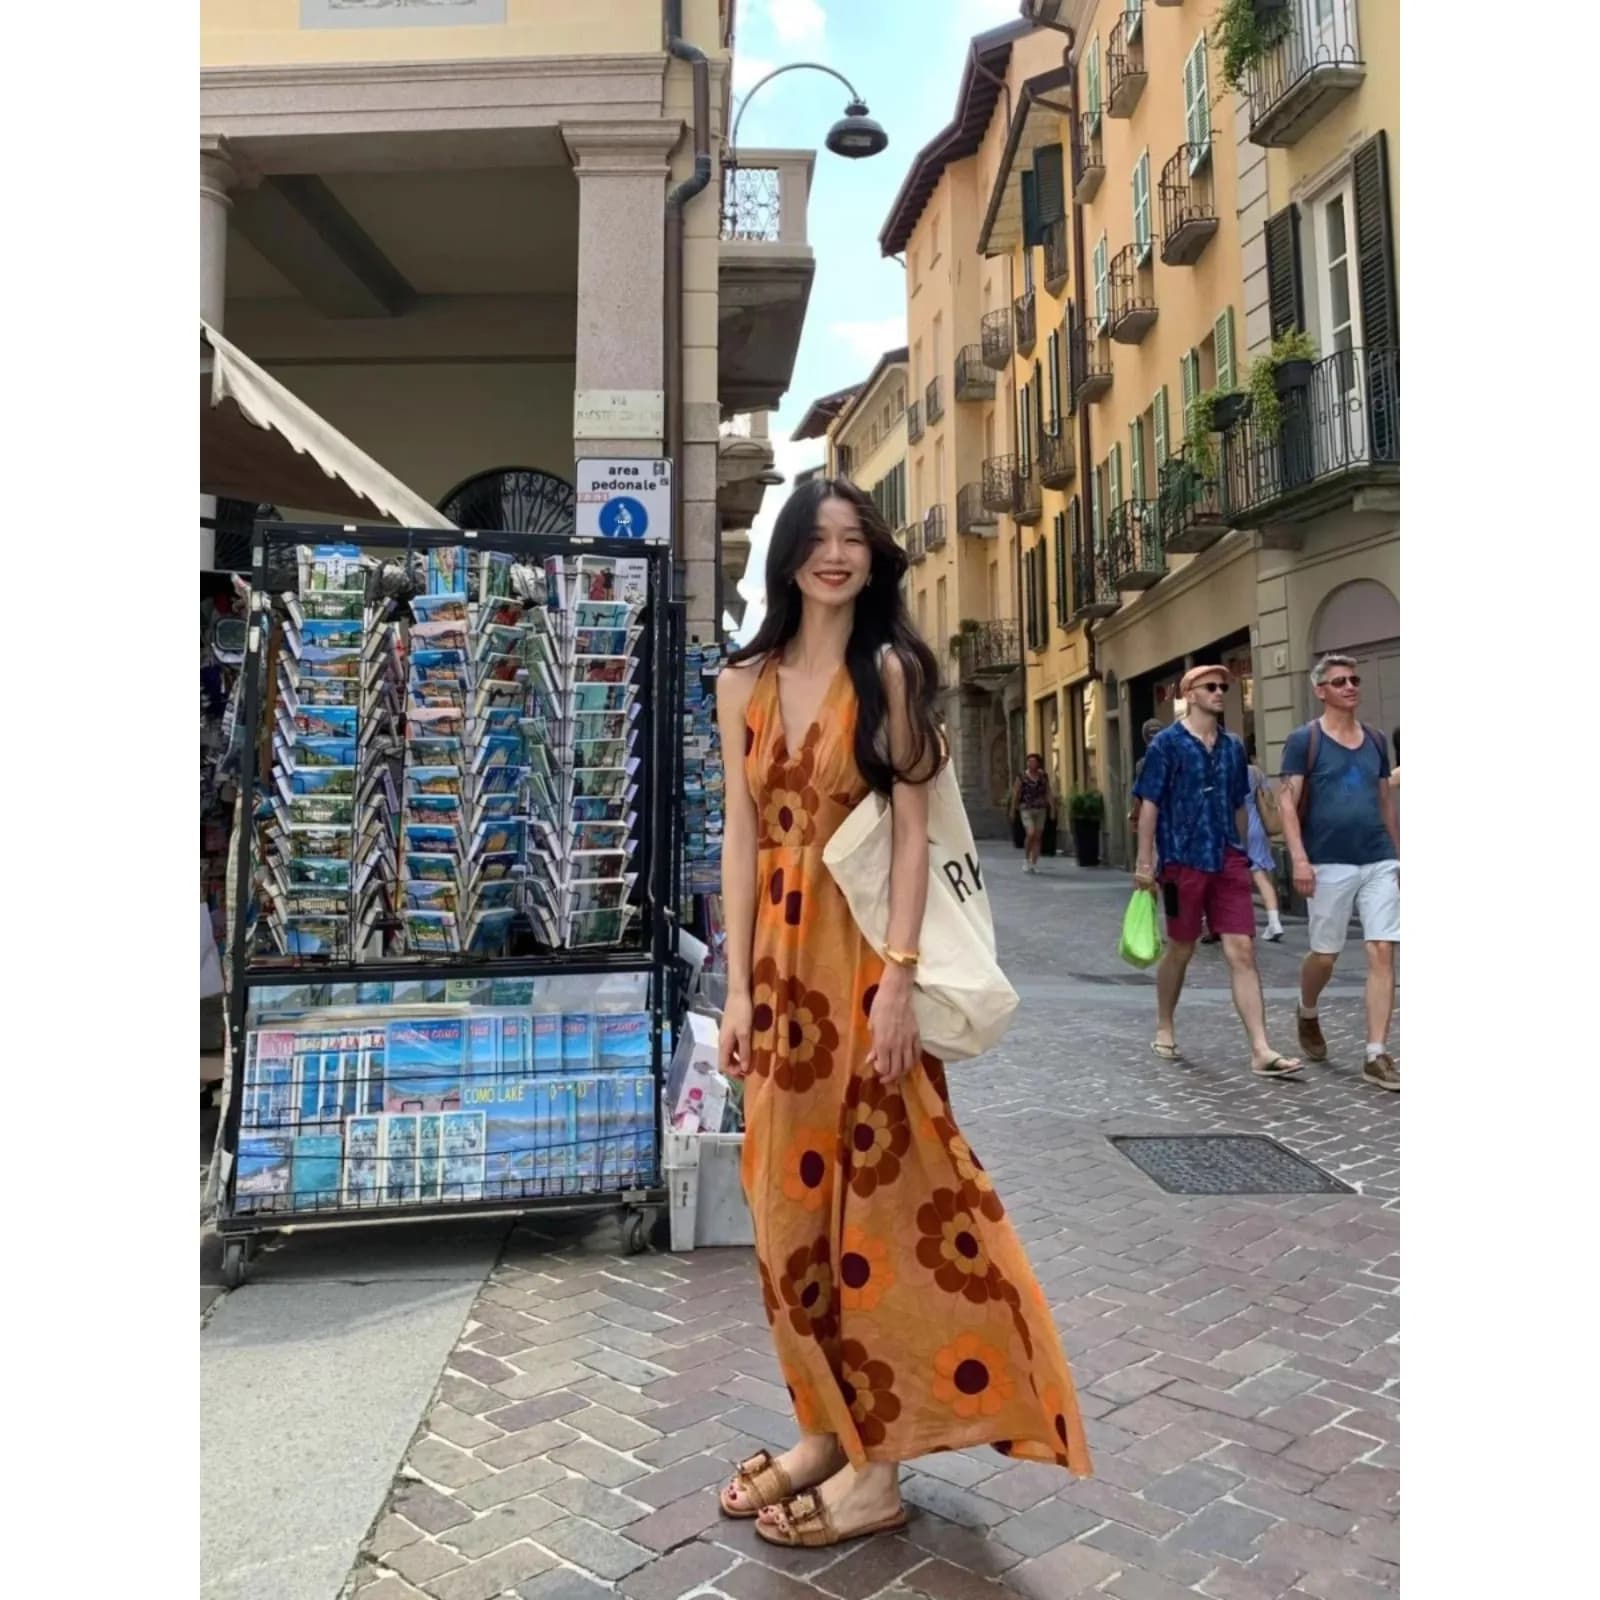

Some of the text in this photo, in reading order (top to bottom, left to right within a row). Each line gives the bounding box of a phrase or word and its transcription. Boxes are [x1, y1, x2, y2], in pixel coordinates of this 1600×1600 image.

[608, 466, 640, 476] area
[591, 480, 657, 491] pedonale
[463, 1084, 525, 1105] COMO LAKE
